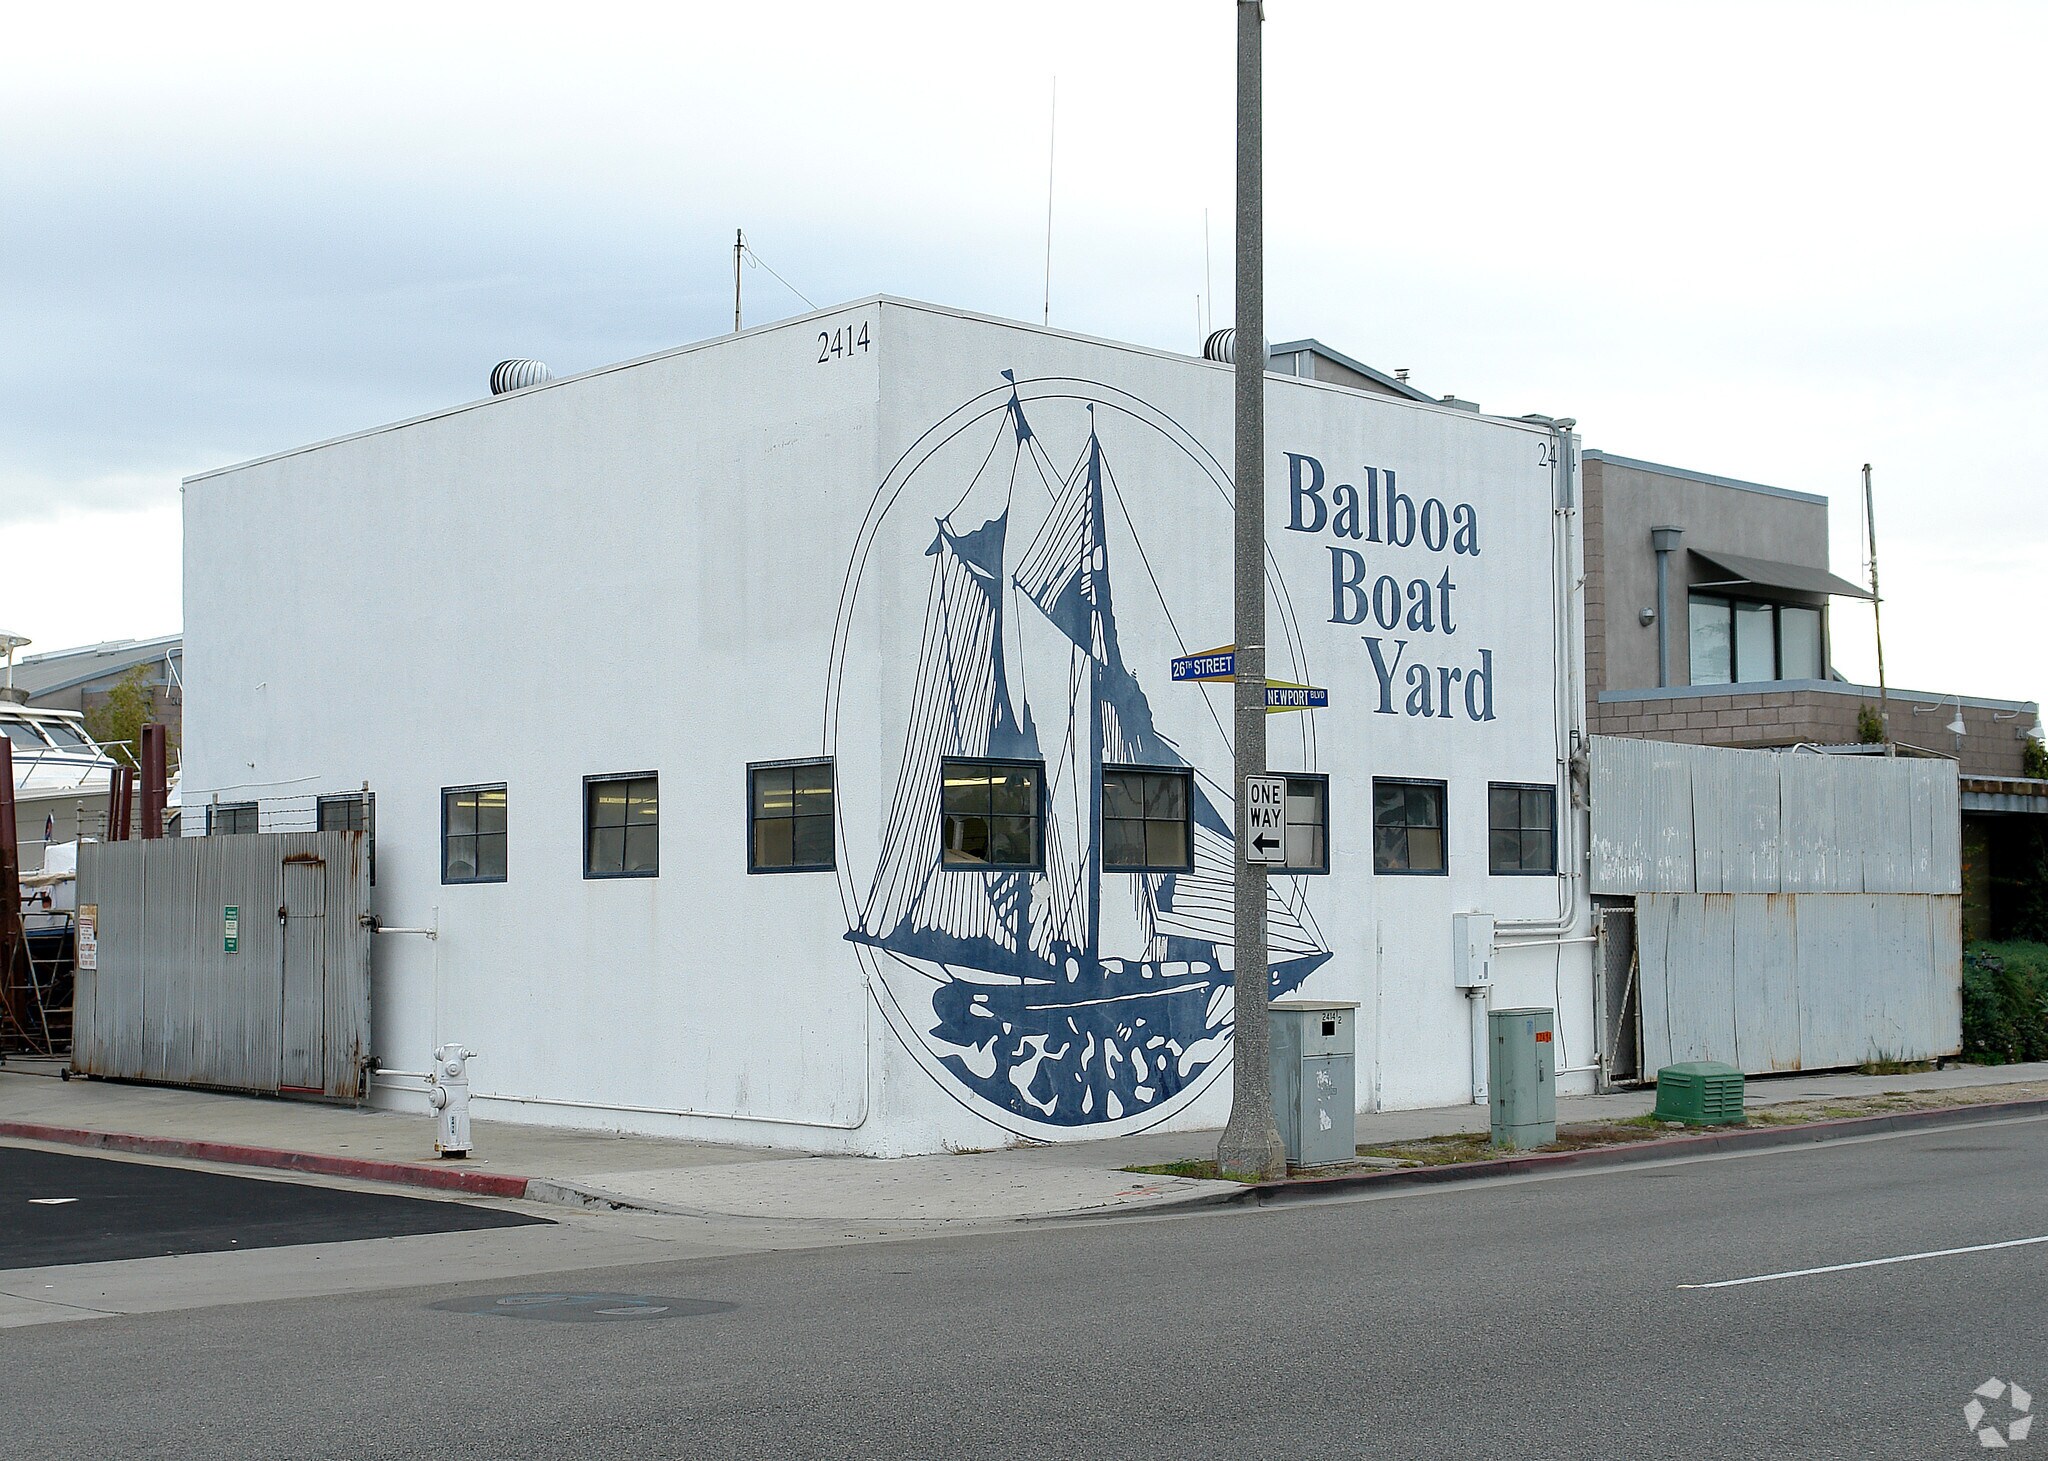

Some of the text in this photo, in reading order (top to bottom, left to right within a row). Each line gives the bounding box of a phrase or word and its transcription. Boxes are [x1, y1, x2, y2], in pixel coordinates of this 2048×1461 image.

[817, 320, 871, 364] 2414
[1283, 452, 1480, 557] Balboa
[1326, 546, 1456, 634] Boat
[1194, 656, 1232, 675] STREET
[1361, 637, 1496, 722] Yard
[1267, 690, 1325, 706] NEWPORT BLVD
[1251, 784, 1281, 804] ONE
[1250, 807, 1281, 827] WAY
